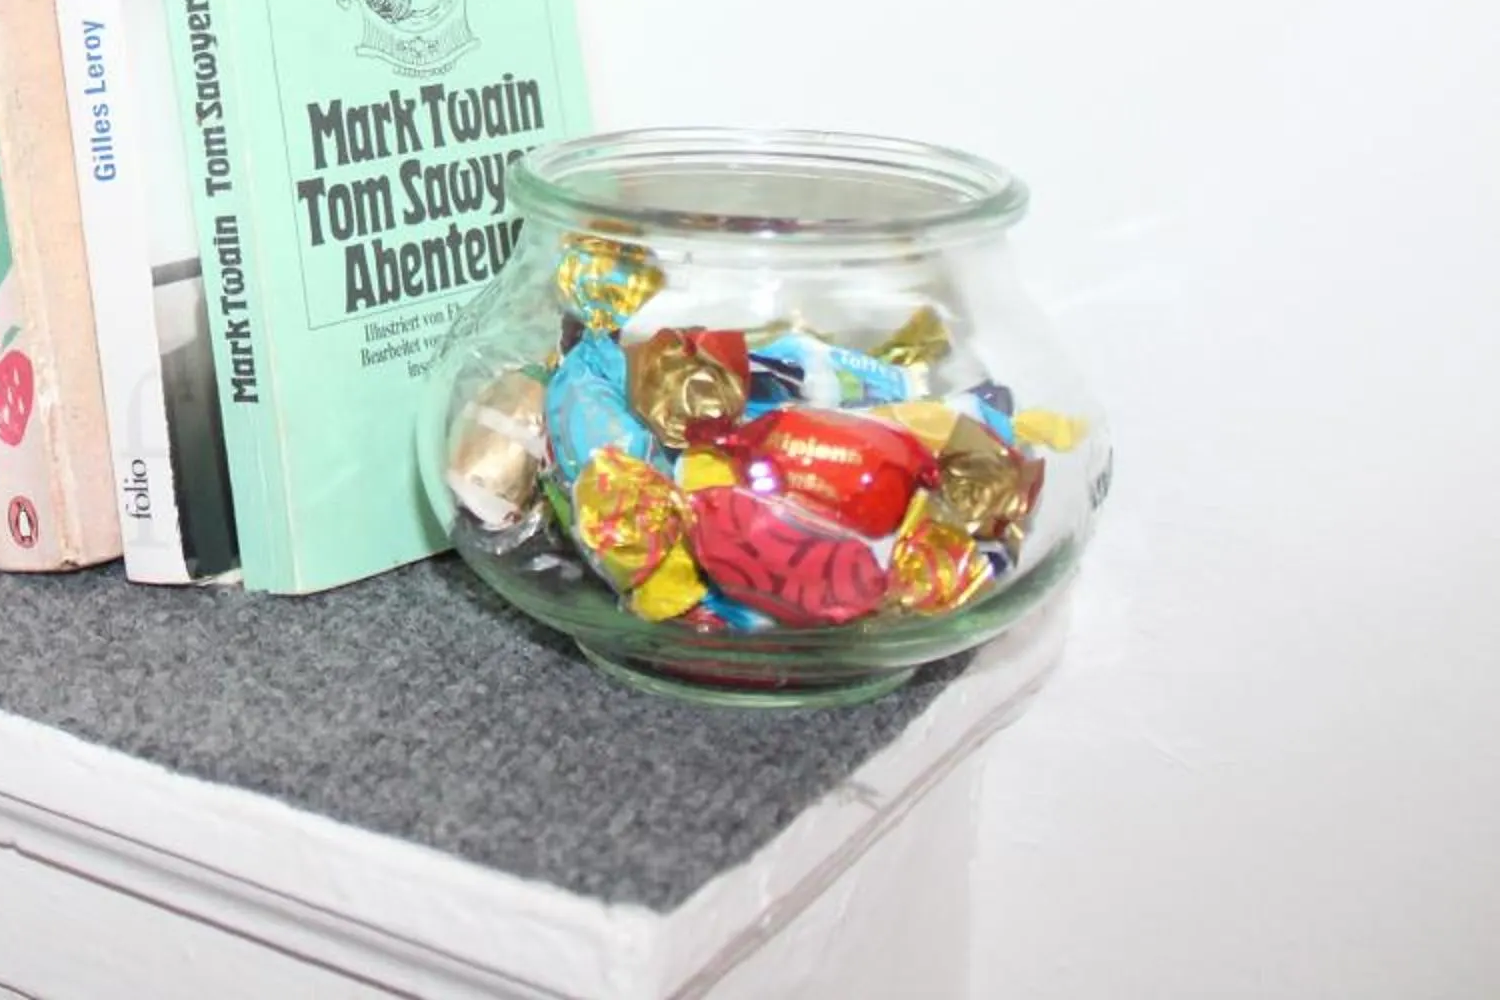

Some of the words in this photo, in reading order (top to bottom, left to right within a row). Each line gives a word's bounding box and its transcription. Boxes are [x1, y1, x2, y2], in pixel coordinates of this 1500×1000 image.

[81, 20, 106, 95] Leroy
[89, 102, 117, 182] Gilles
[204, 126, 233, 197] Tom
[307, 89, 424, 170] Mark
[419, 73, 544, 148] Twain
[297, 175, 397, 247] Tom
[399, 146, 536, 226] Sawy
[213, 214, 248, 315] Twain
[225, 315, 260, 404] Mark
[123, 458, 152, 520] folio
